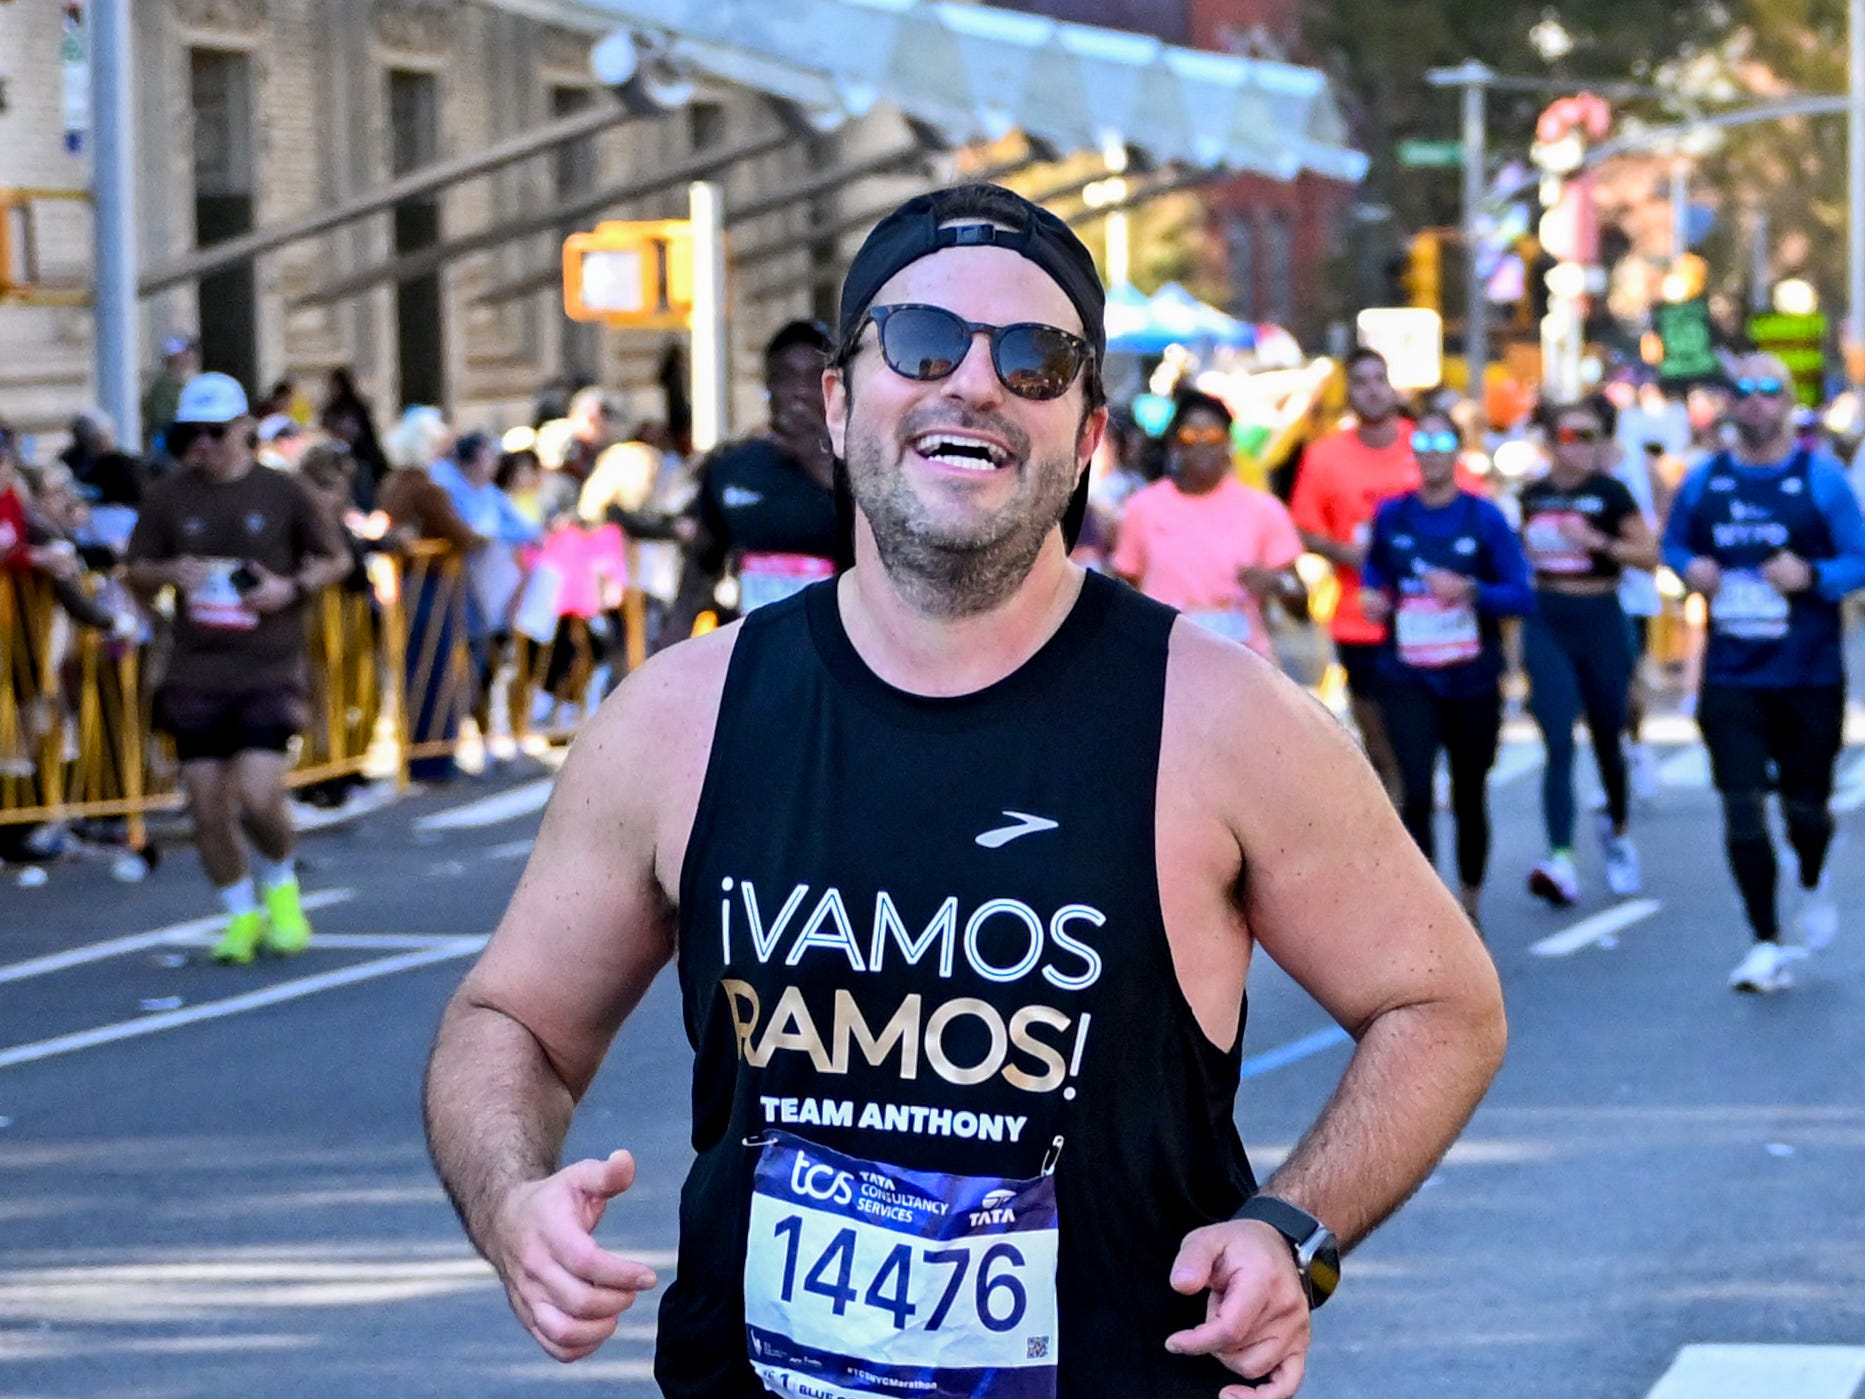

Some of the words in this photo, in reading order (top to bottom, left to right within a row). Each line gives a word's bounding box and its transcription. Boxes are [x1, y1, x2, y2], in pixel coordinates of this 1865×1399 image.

[721, 876, 1107, 991] ¡VAMOS
[722, 979, 1091, 1101] RAMOS!
[760, 1096, 855, 1128] TEAM
[857, 1103, 1028, 1143] ANTHONY
[790, 1148, 856, 1206] tcs
[859, 1171, 896, 1191] TATA
[861, 1183, 949, 1217] CONSULTANCY
[856, 1199, 914, 1224] SERVICES
[969, 1208, 1016, 1228] TATA
[773, 1213, 1028, 1334] 14476
